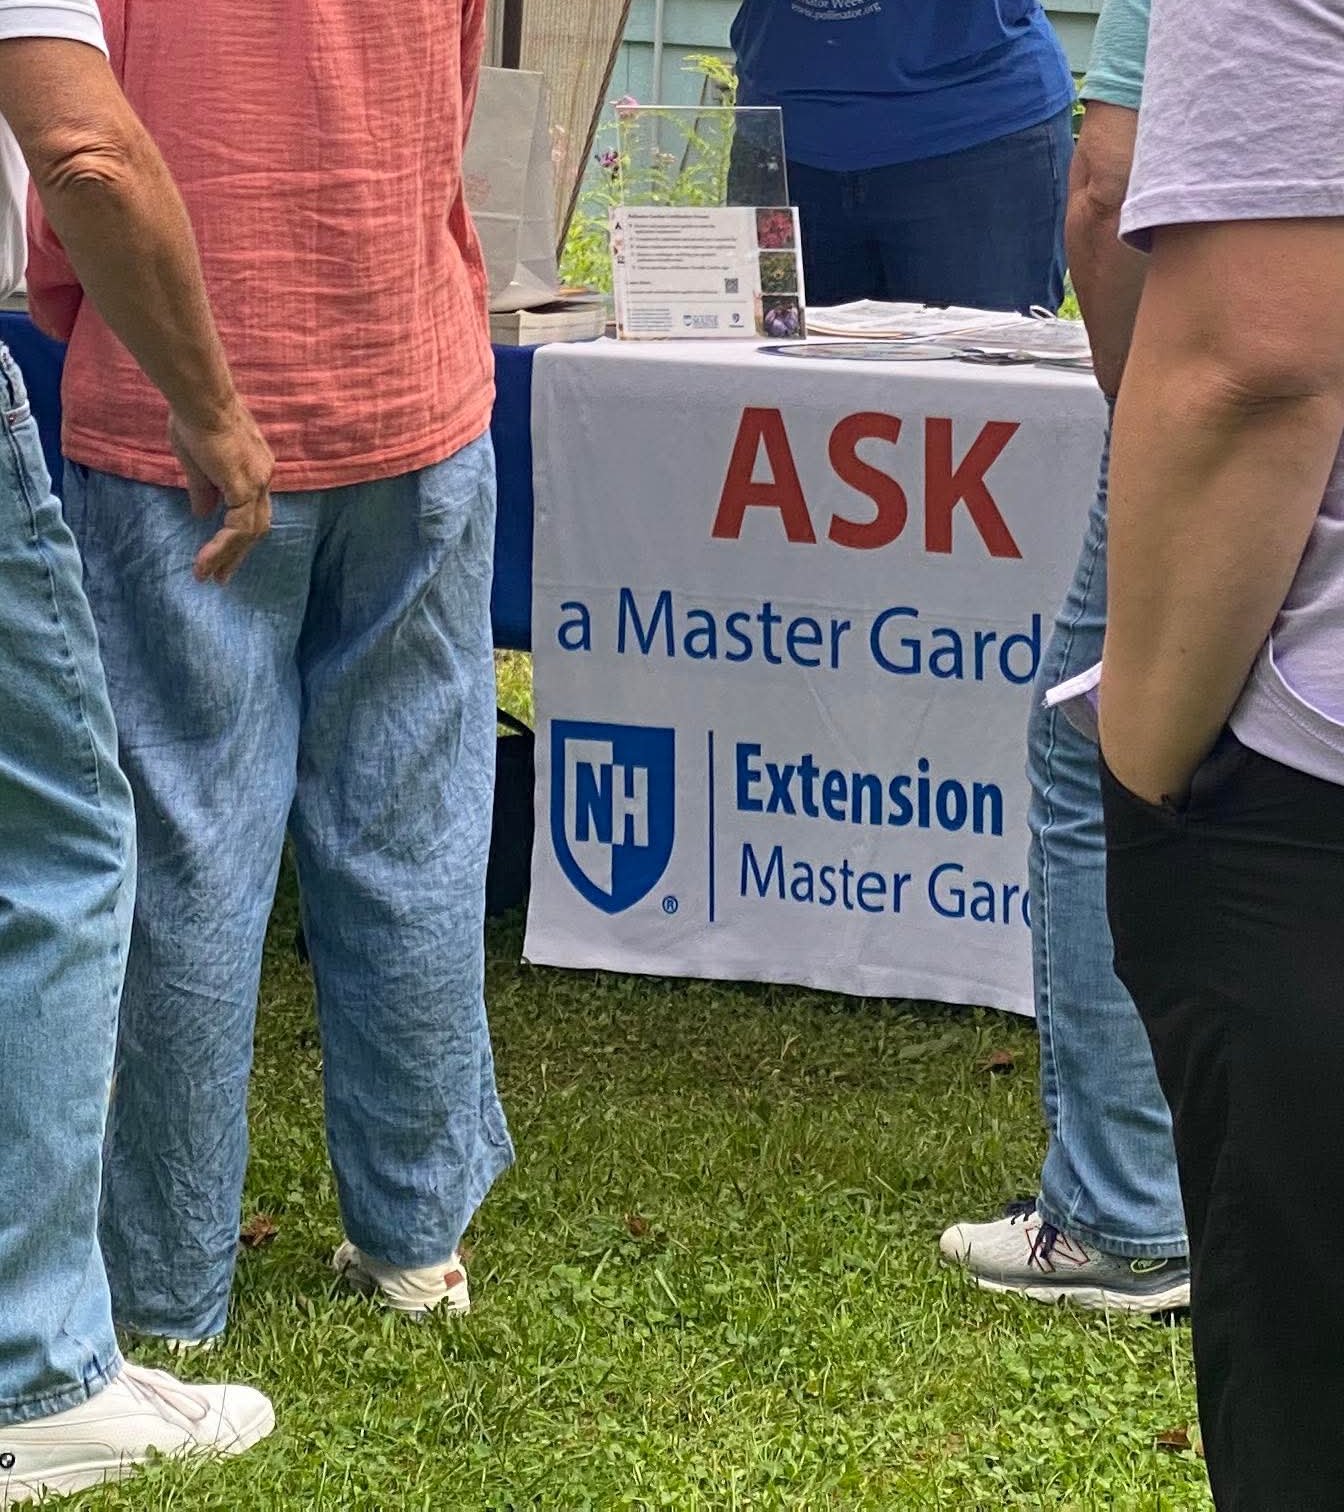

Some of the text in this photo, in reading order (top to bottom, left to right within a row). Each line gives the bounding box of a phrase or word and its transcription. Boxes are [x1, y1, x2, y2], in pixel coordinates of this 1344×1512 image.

[711, 406, 1024, 559] ASK
[557, 600, 592, 653] a
[617, 587, 852, 669] Master
[574, 761, 649, 848] NH
[736, 742, 1003, 836] Extension
[740, 842, 912, 913] Master
